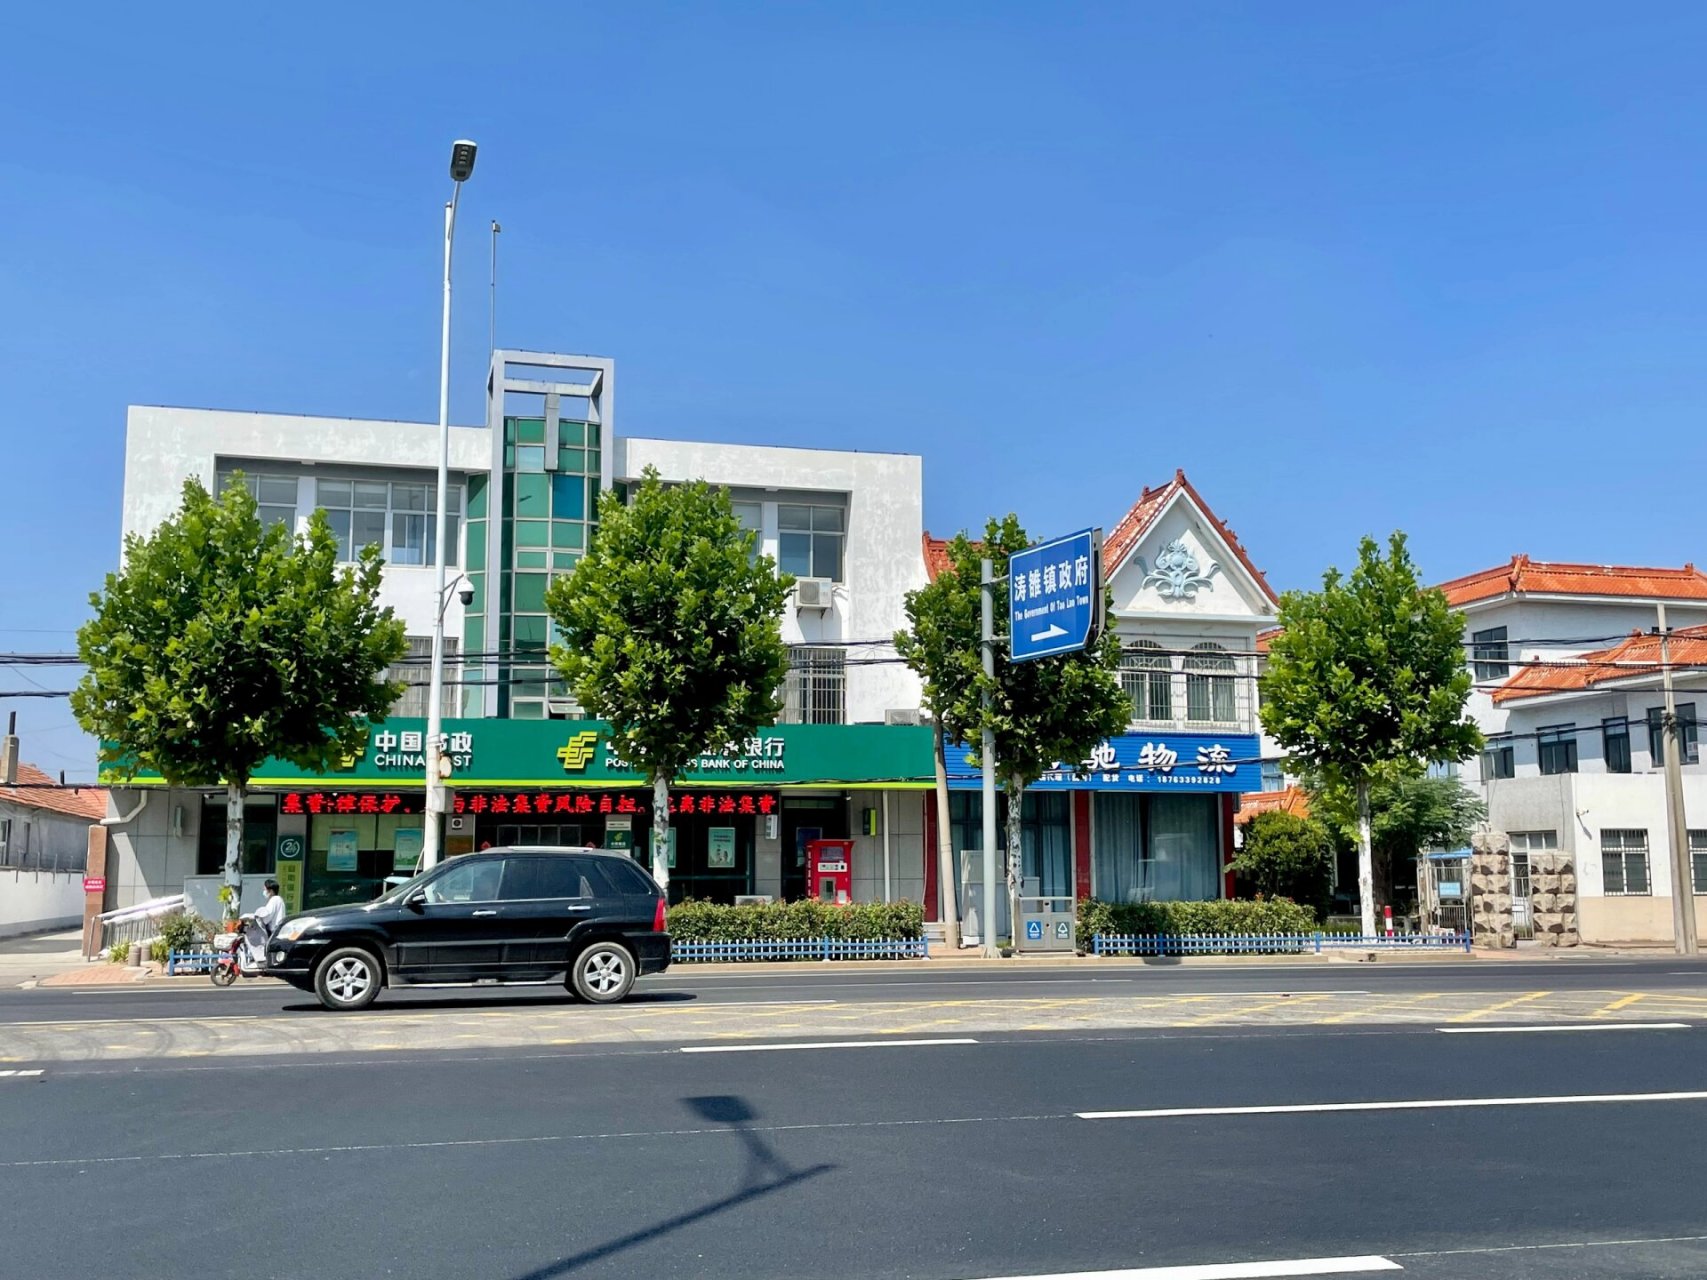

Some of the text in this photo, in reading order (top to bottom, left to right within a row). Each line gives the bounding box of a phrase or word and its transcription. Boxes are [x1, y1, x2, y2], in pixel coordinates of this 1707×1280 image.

[1014, 611, 1023, 621] The
[374, 754, 426, 767] CHINA
[701, 759, 730, 769] BANK
[733, 759, 748, 769] OF
[751, 760, 785, 770] CHINA
